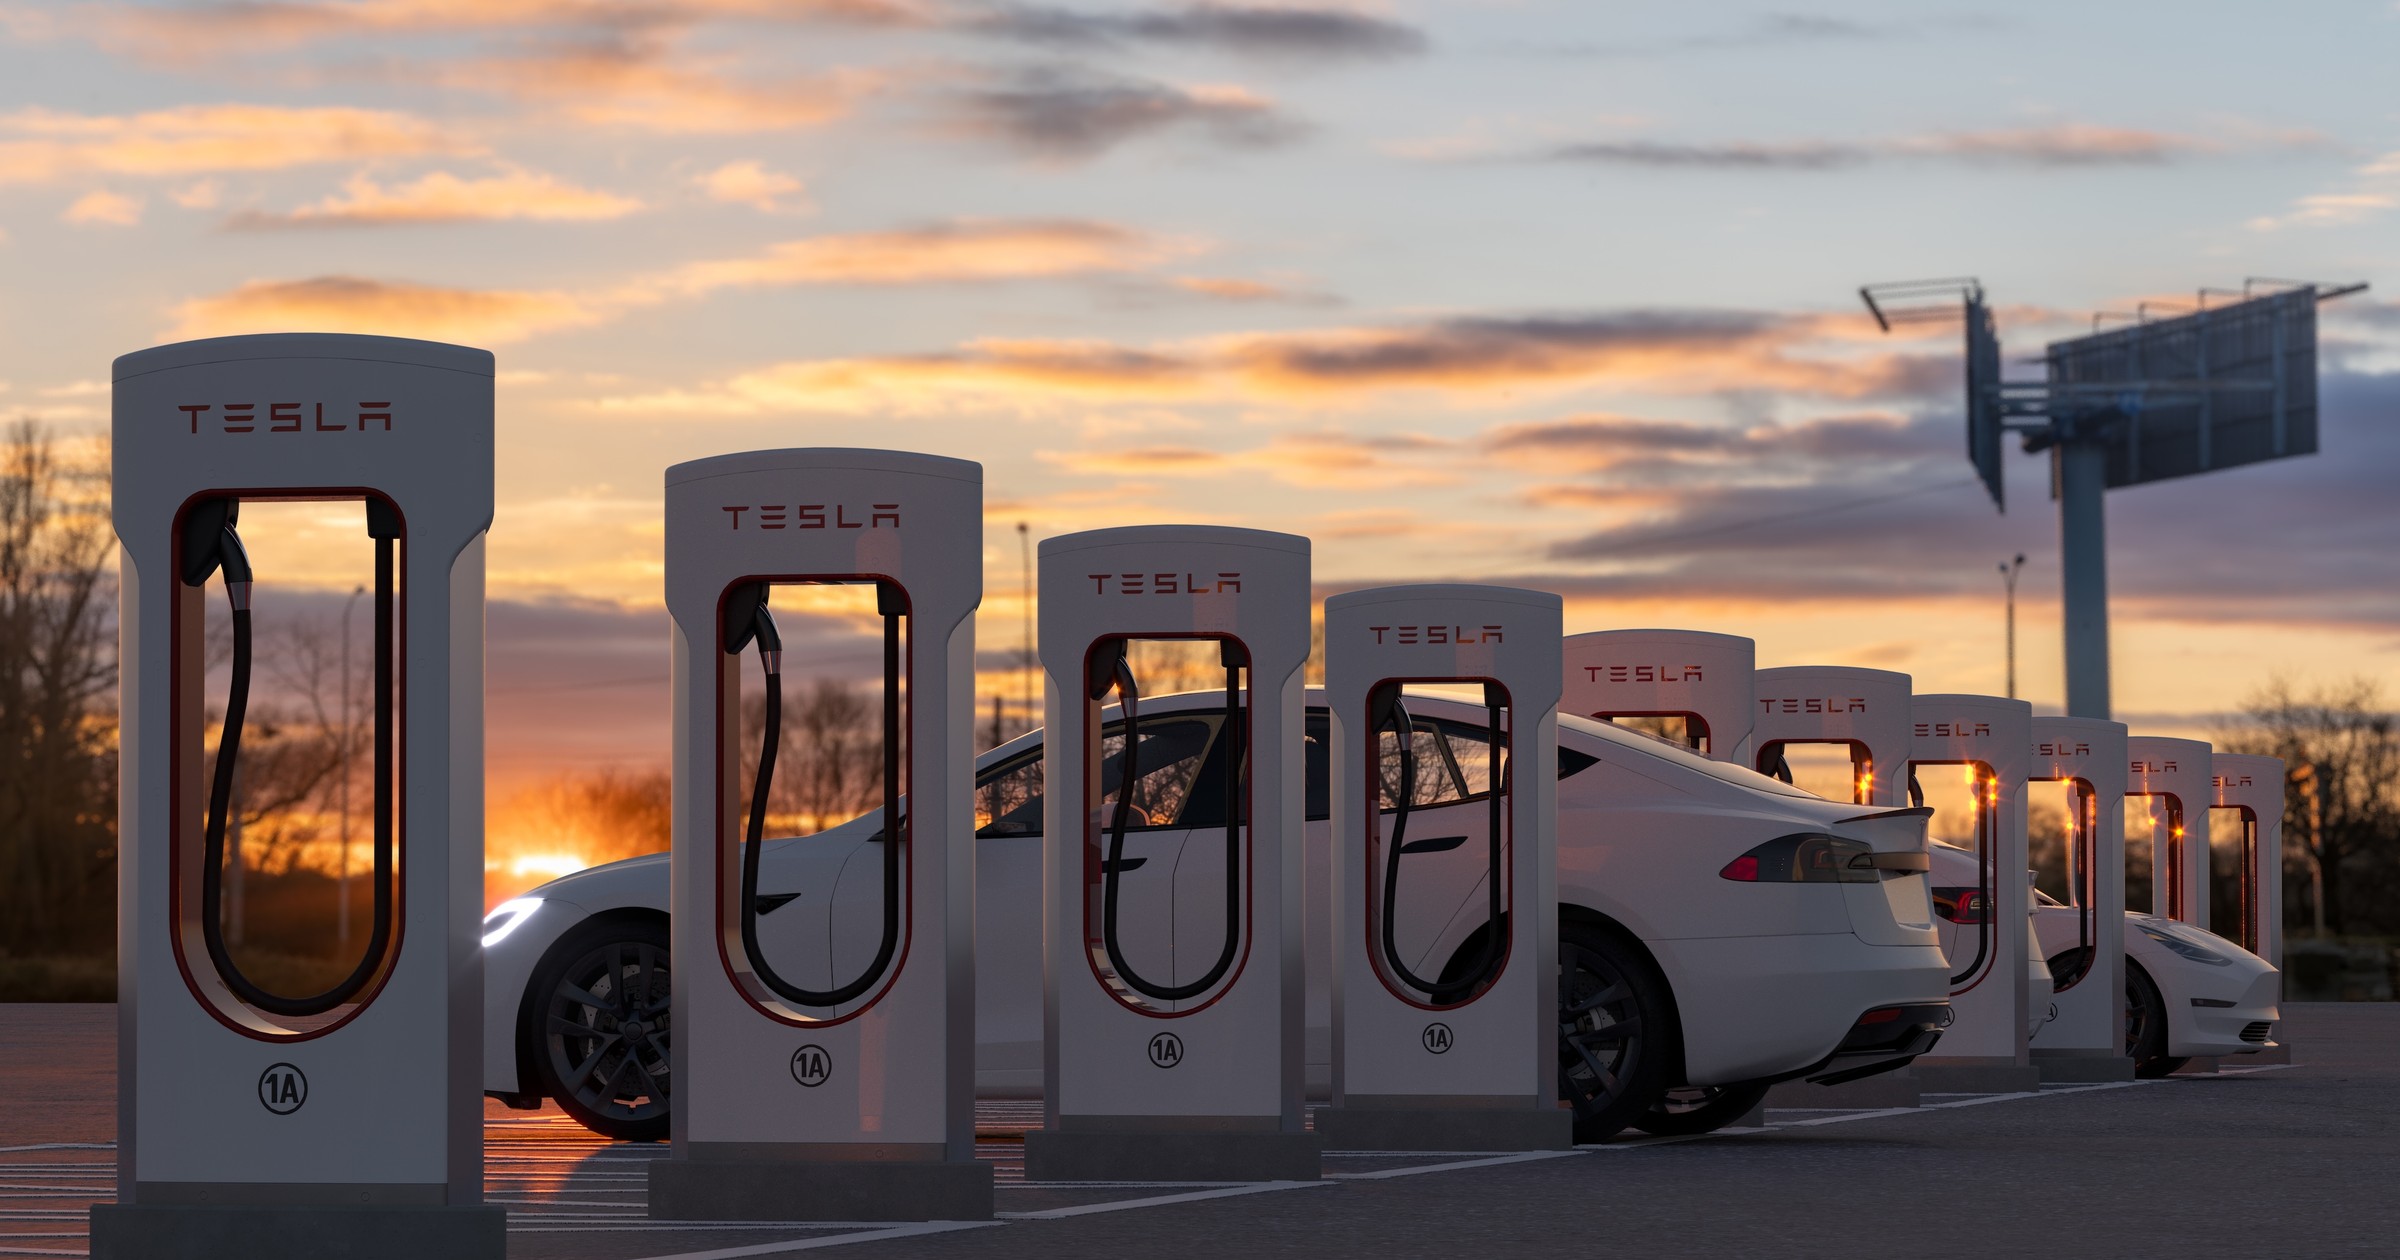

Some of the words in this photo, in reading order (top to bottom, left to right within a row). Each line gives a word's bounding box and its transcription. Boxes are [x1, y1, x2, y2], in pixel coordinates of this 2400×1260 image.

[178, 402, 391, 434] TESLA
[722, 504, 899, 529] TESLA
[1088, 573, 1240, 594] TESLA
[1369, 626, 1502, 645] TESLA
[1584, 666, 1702, 682] TESLA
[1760, 699, 1865, 713] TESLA
[1914, 724, 1990, 737] ESLA
[2032, 744, 2090, 755] SLA
[2131, 762, 2177, 773] SLA
[2212, 777, 2251, 787] SLA
[1426, 1029, 1447, 1047] 1A
[1153, 1040, 1177, 1060] 1A
[795, 1053, 824, 1077] 1A
[265, 1073, 299, 1104] 1A
